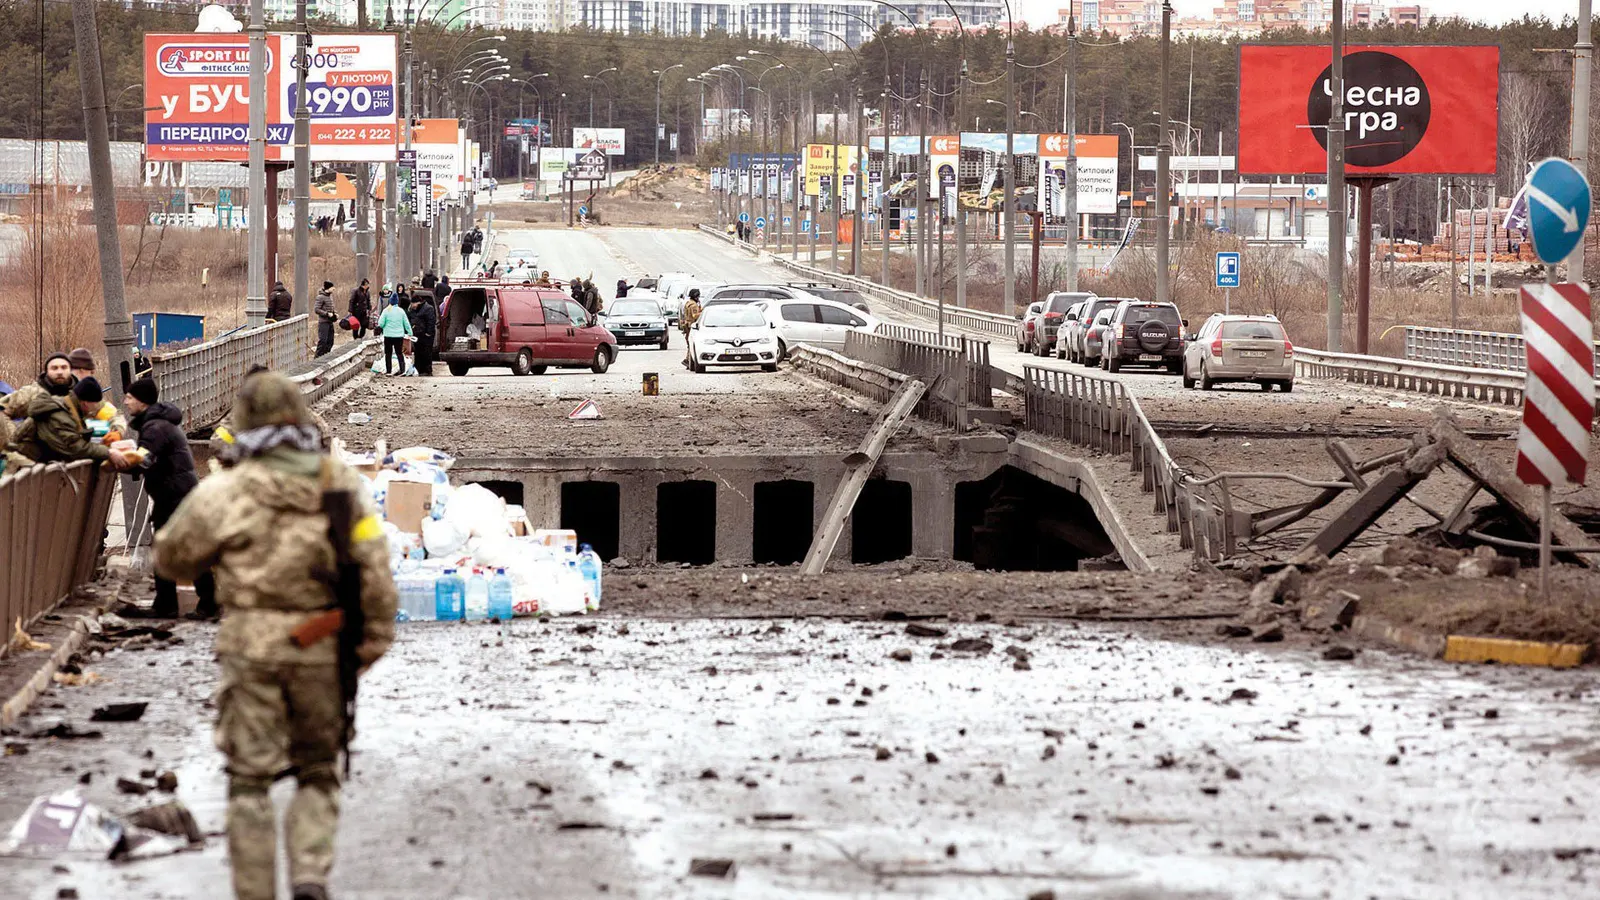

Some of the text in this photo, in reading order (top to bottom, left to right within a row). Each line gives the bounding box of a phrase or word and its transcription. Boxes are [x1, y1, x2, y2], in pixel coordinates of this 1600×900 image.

[189, 50, 232, 61] SPORT
[341, 73, 389, 84] лютому
[373, 90, 389, 99] грн
[160, 84, 250, 119] у БУЧ
[373, 100, 389, 110] рік
[334, 129, 356, 139] 222
[359, 129, 366, 139] 4
[369, 129, 391, 139] 222
